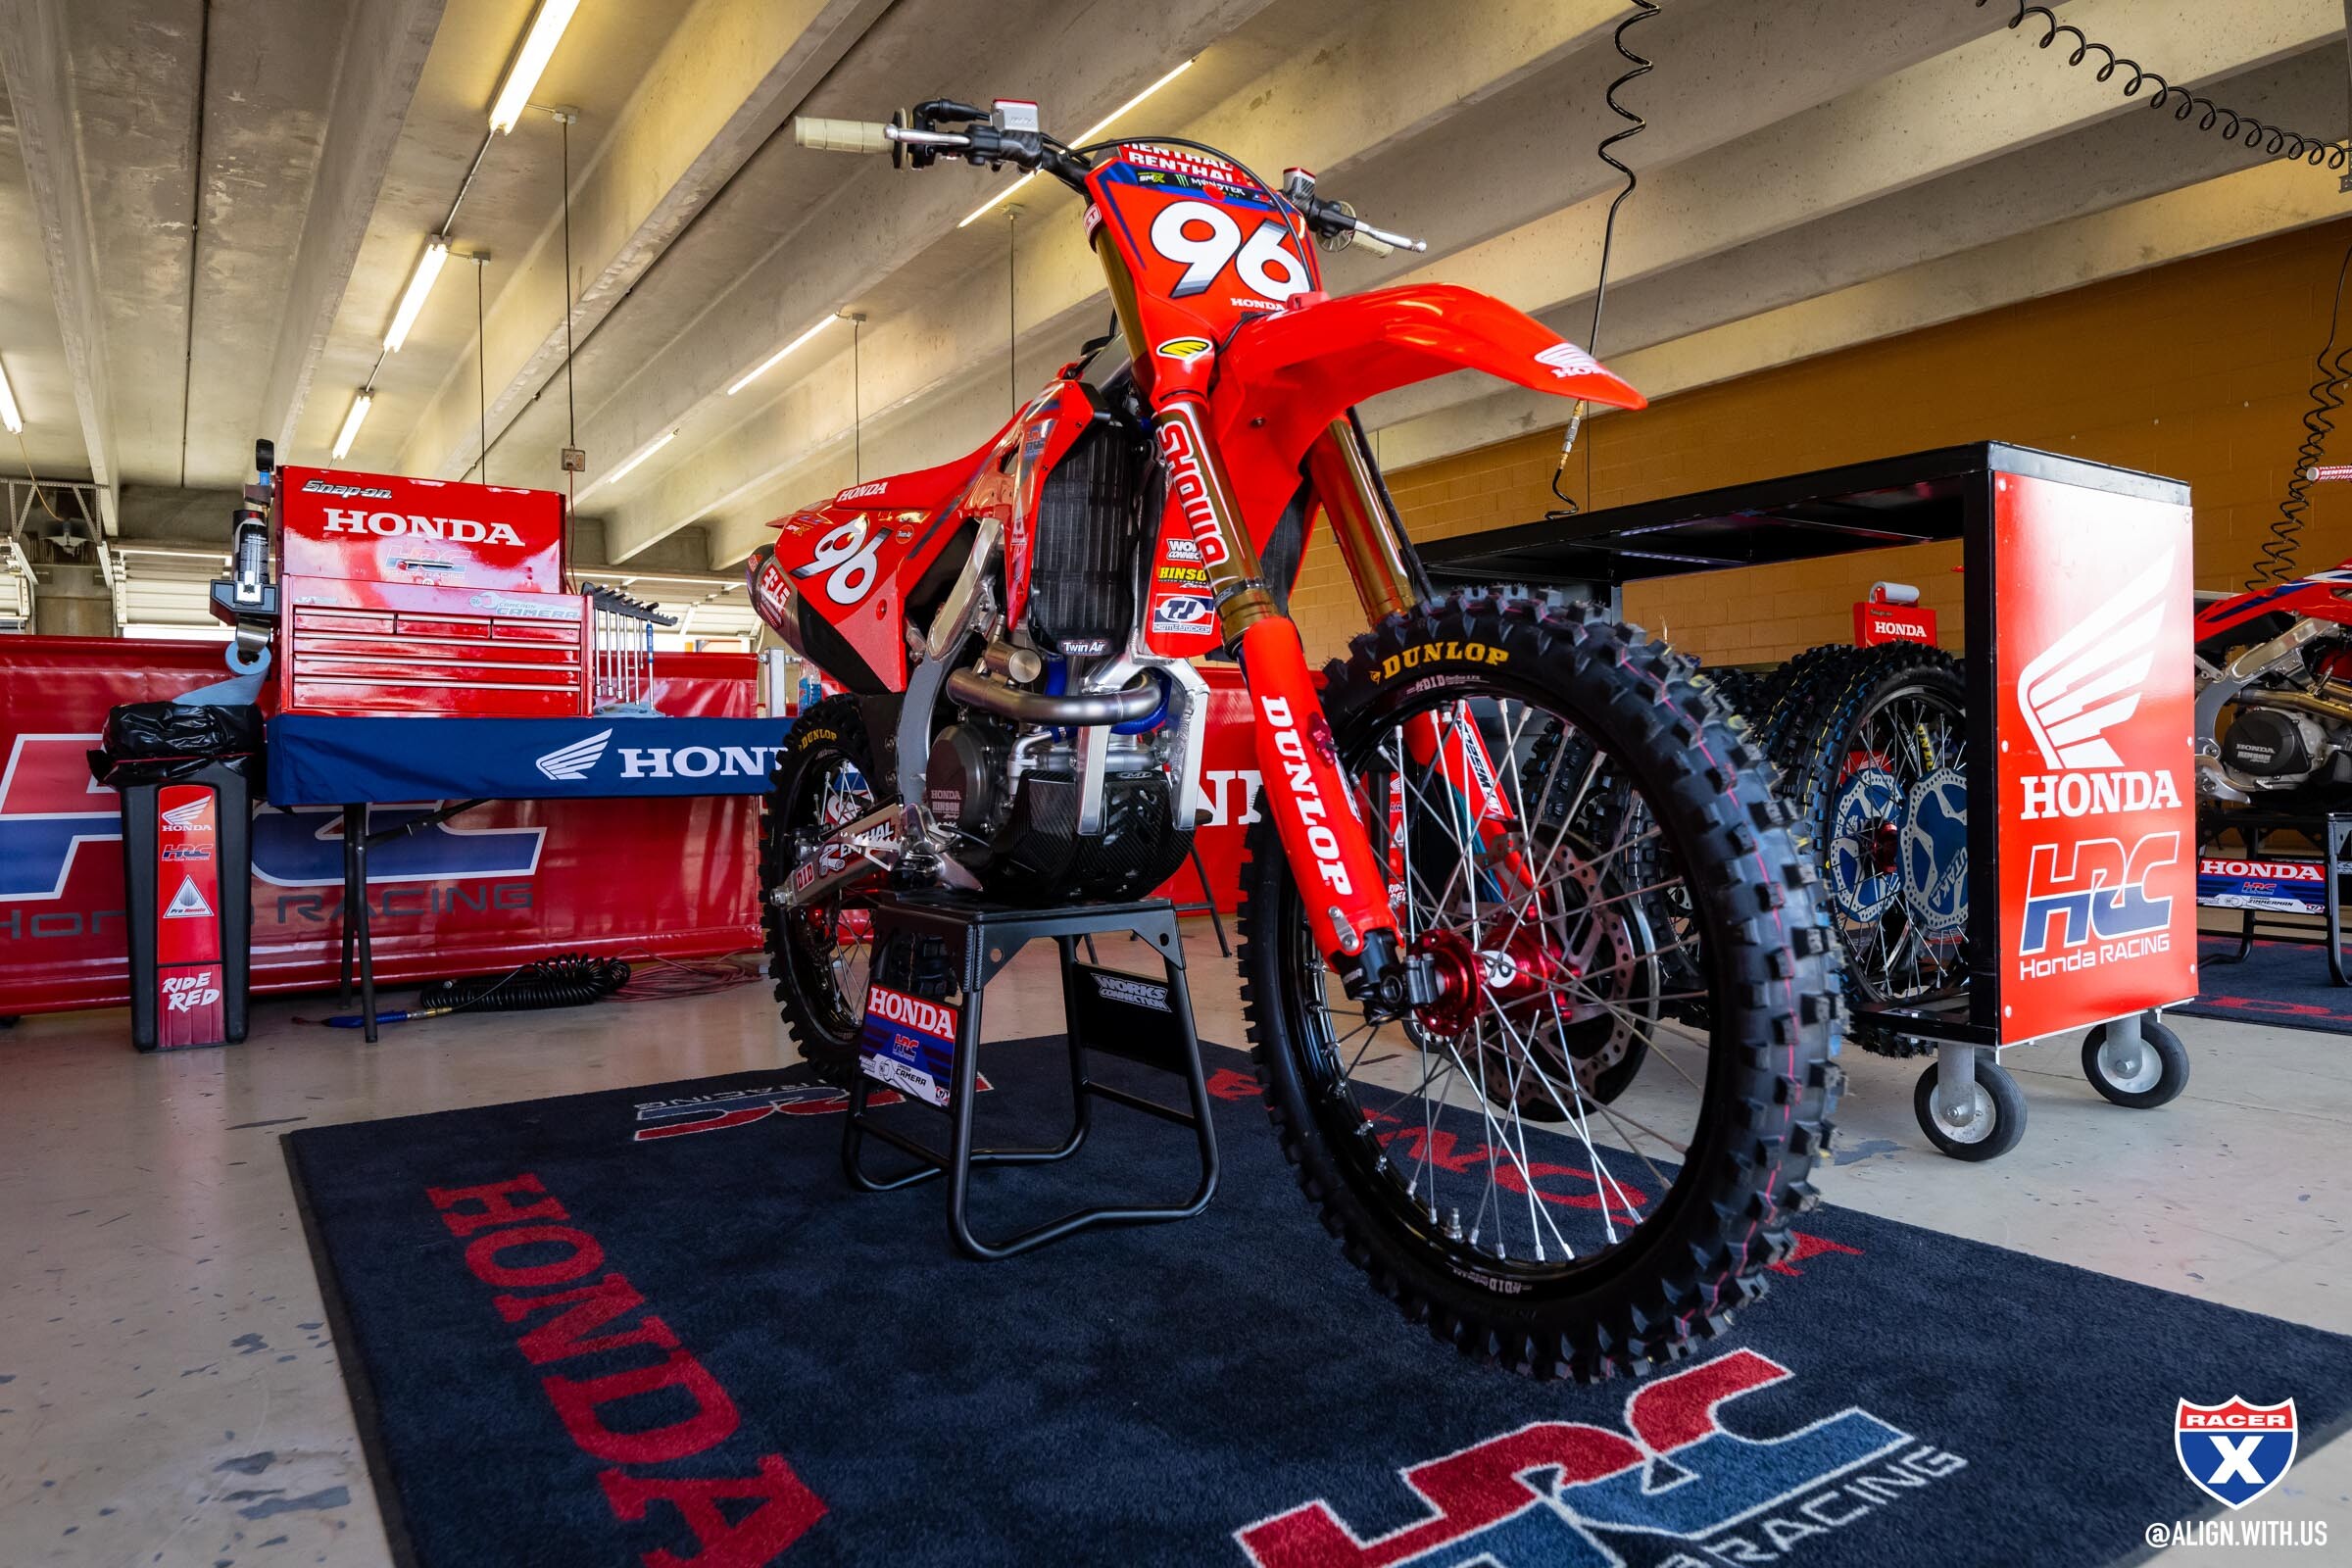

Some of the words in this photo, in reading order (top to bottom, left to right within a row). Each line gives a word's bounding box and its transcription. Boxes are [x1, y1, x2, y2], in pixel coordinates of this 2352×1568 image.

[1151, 200, 1311, 303] 96
[1230, 297, 1287, 312] HONDA
[302, 479, 392, 499] Snap-on
[837, 481, 888, 503] HONDA
[1155, 420, 1230, 568] SHOWA
[323, 508, 526, 548] HONDA
[790, 512, 893, 605] 96
[1159, 566, 1207, 581] HINSO
[496, 607, 581, 620] CAMERA
[1167, 600, 1198, 619] TJ
[1875, 621, 1928, 637] HONDA
[1063, 640, 1089, 653] Twin
[1090, 641, 1106, 653] Air
[1382, 641, 1510, 679] DUNLOP
[801, 728, 838, 751] DUNLOP
[2235, 744, 2276, 754] HONDA
[617, 747, 789, 778] HON
[930, 790, 961, 800] HONDA
[1261, 695, 1353, 896] DUNLOP
[2020, 769, 2182, 820] HONDA
[162, 843, 214, 859] HRC
[797, 865, 814, 889] DID
[2201, 860, 2324, 880] HONDA
[278, 884, 534, 925] RACING
[2019, 831, 2180, 956] HRC
[2020, 949, 2096, 981] Honda
[2100, 933, 2171, 964] RACING
[162, 972, 212, 994] RIDE
[1098, 976, 1166, 1001] WORKS
[168, 988, 220, 1013] RED
[1100, 988, 1168, 1010] CONNECTION
[868, 987, 956, 1040] HONDA
[893, 1034, 920, 1058] HRC
[896, 1068, 927, 1087] CAMERA
[426, 1173, 830, 1568] HONDA
[1705, 1444, 1970, 1566] RACING
